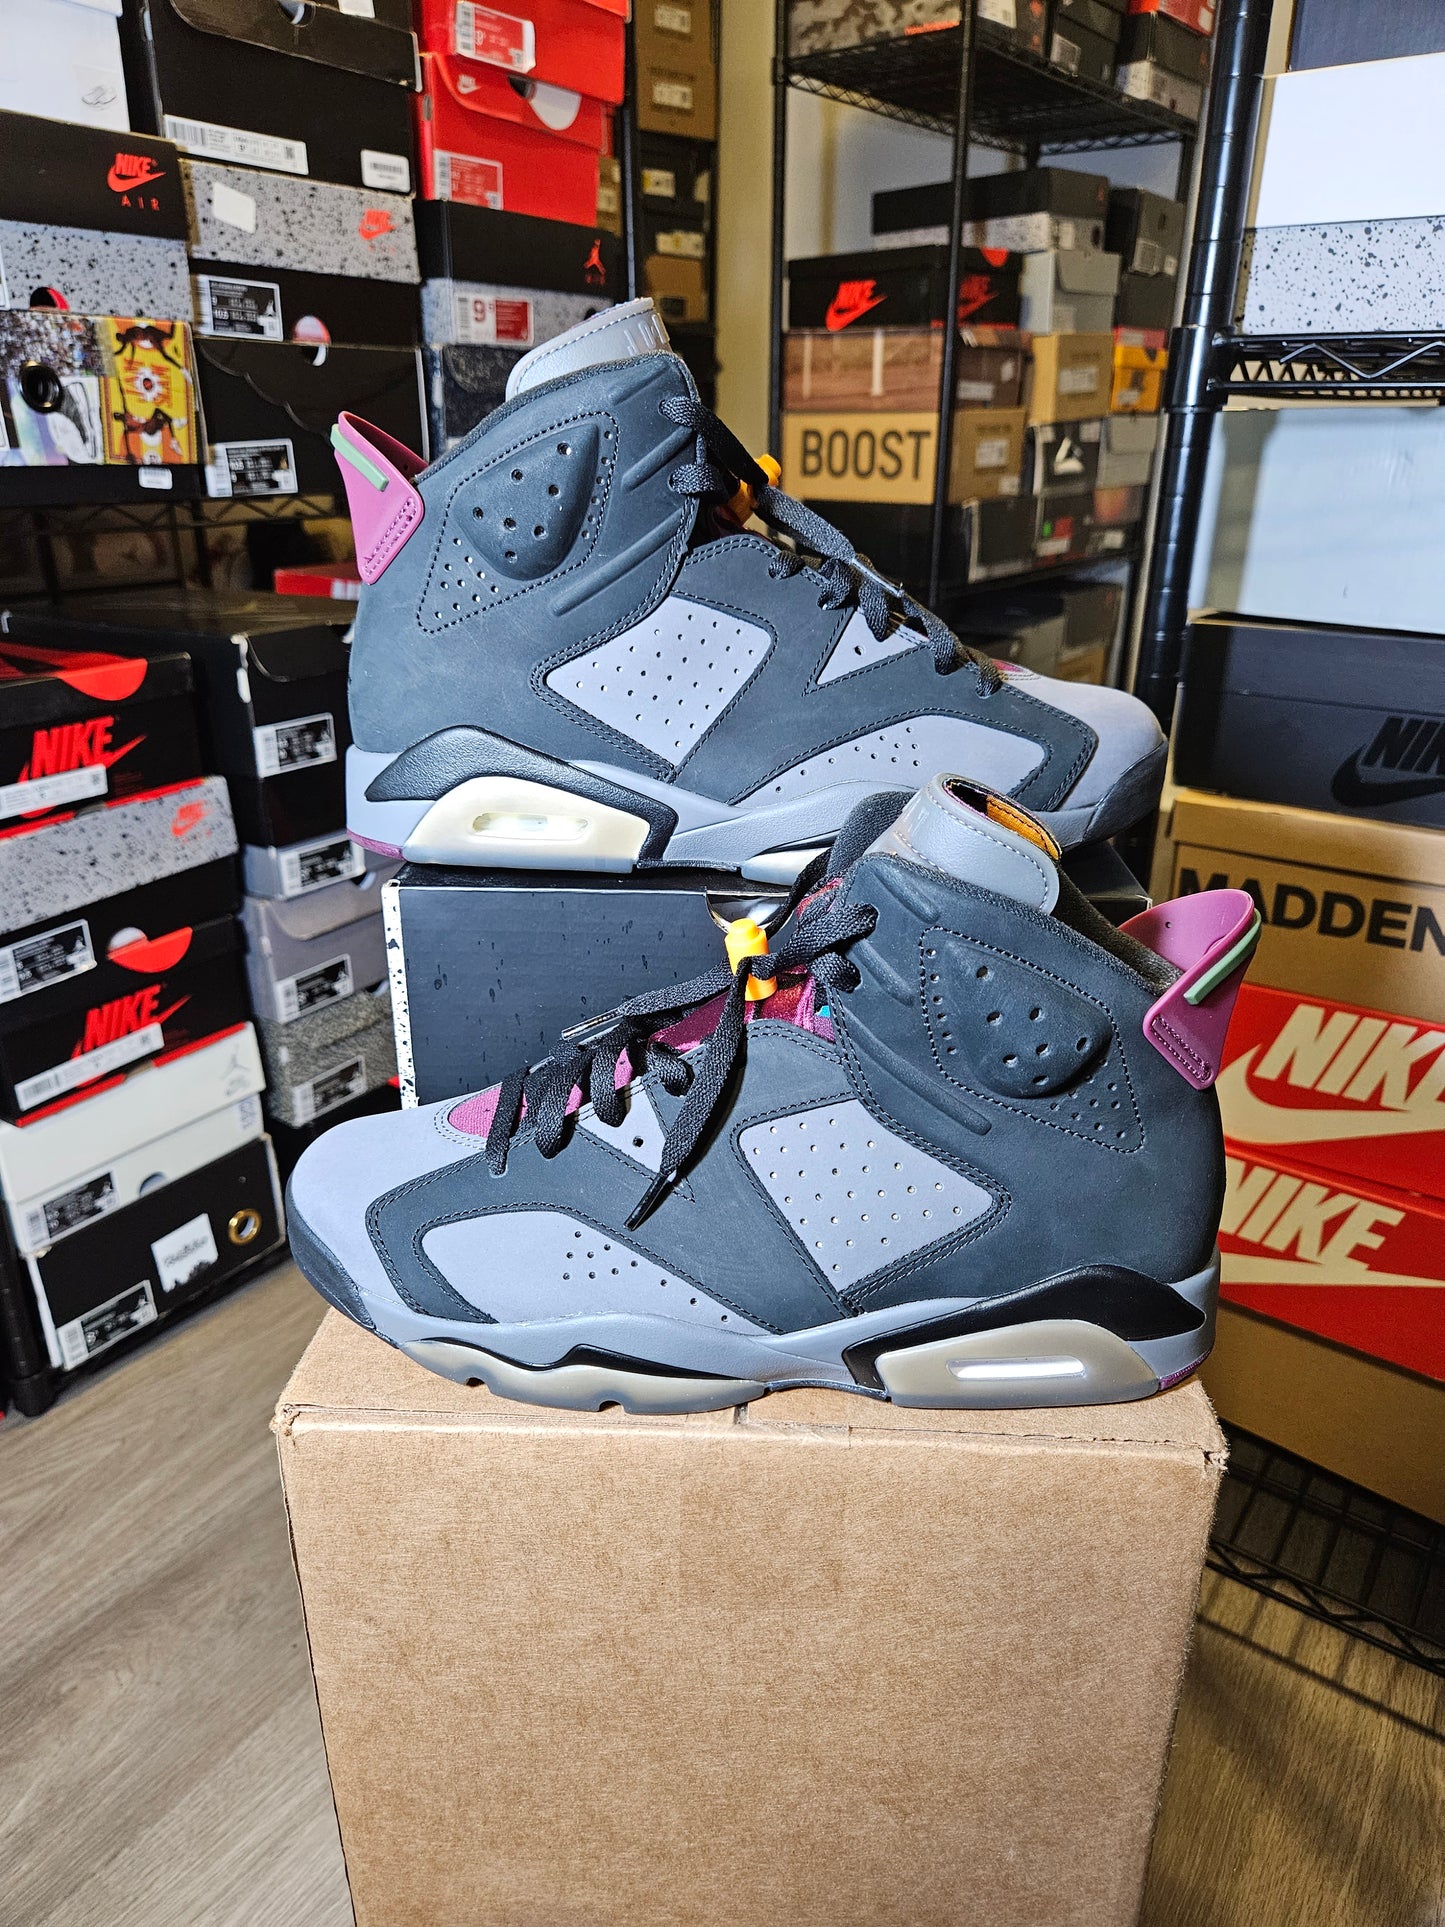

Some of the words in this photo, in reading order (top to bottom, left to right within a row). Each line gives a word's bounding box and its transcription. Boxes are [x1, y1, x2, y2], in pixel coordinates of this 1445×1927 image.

[115, 153, 151, 176] NIKE
[121, 195, 160, 211] AIR
[801, 430, 931, 480] BOOST
[30, 715, 115, 779] NIKE
[1361, 715, 1445, 775] NI
[83, 984, 161, 1052] NIKE
